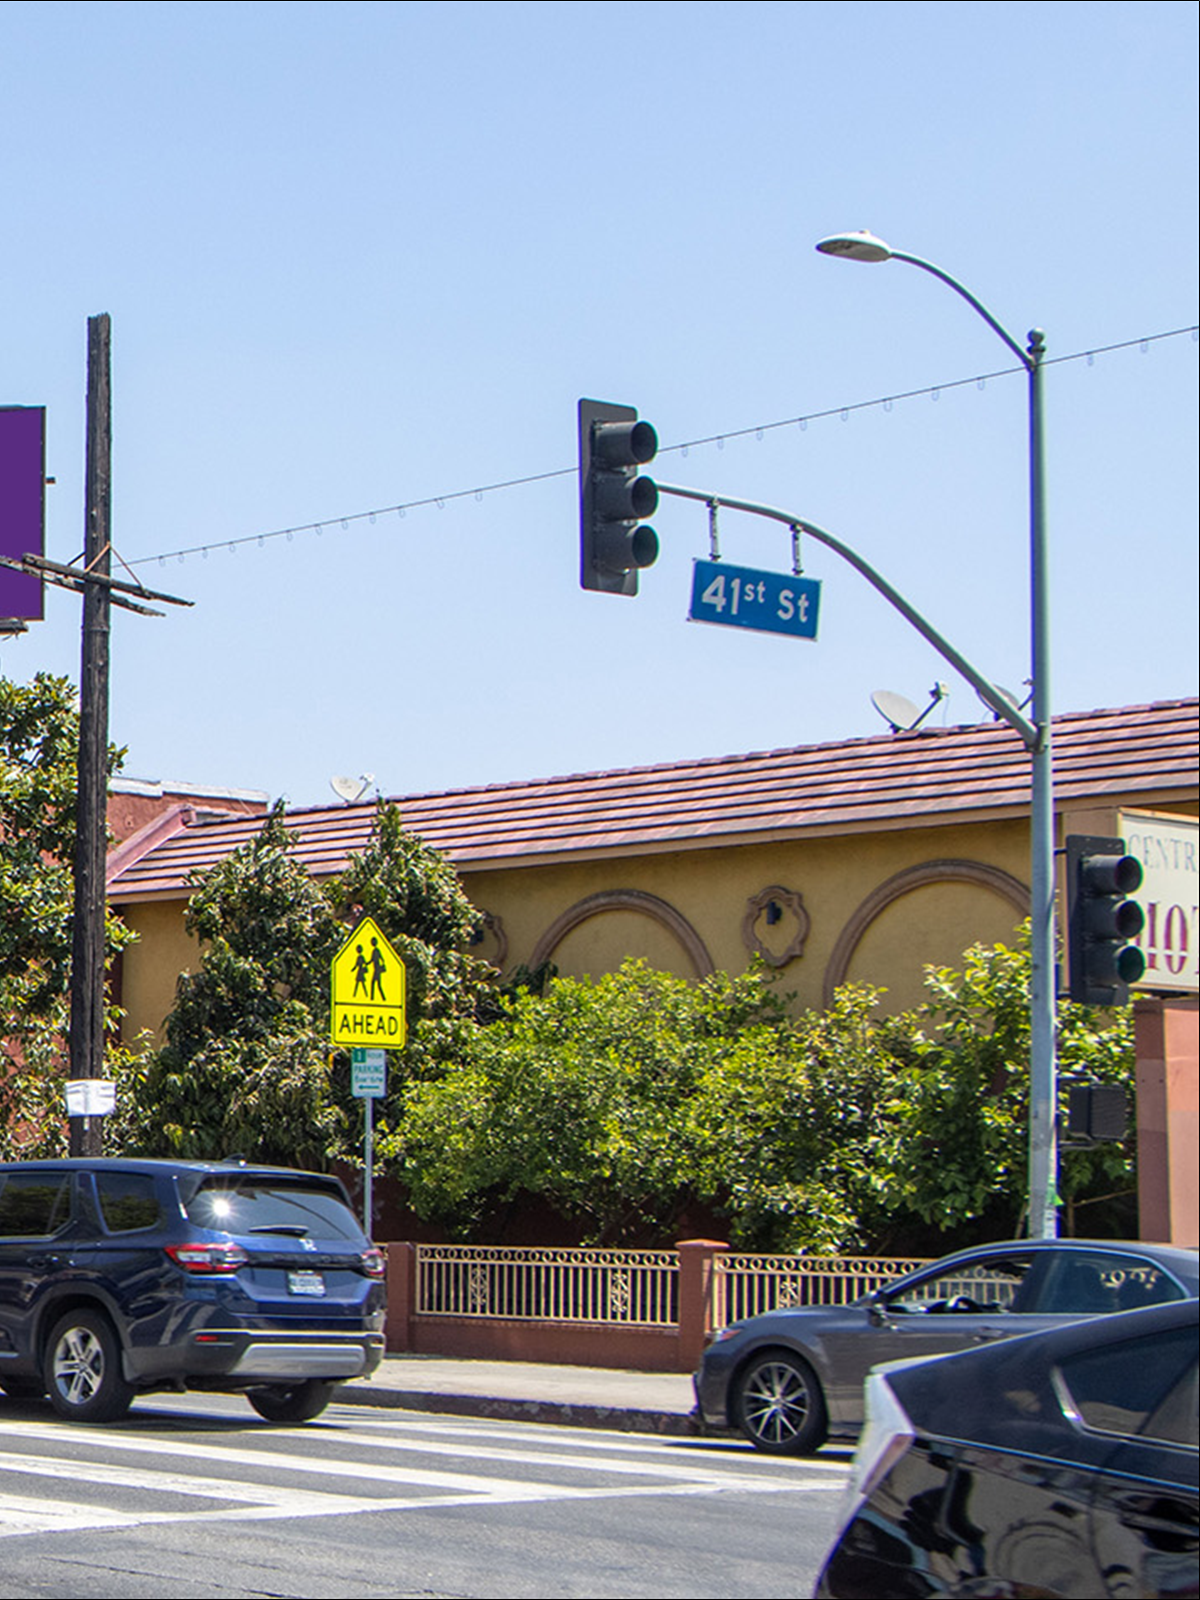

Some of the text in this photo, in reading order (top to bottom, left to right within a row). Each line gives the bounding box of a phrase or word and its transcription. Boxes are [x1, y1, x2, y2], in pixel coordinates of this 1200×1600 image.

[701, 575, 809, 623] 41st St
[338, 1013, 399, 1036] AHEAD
